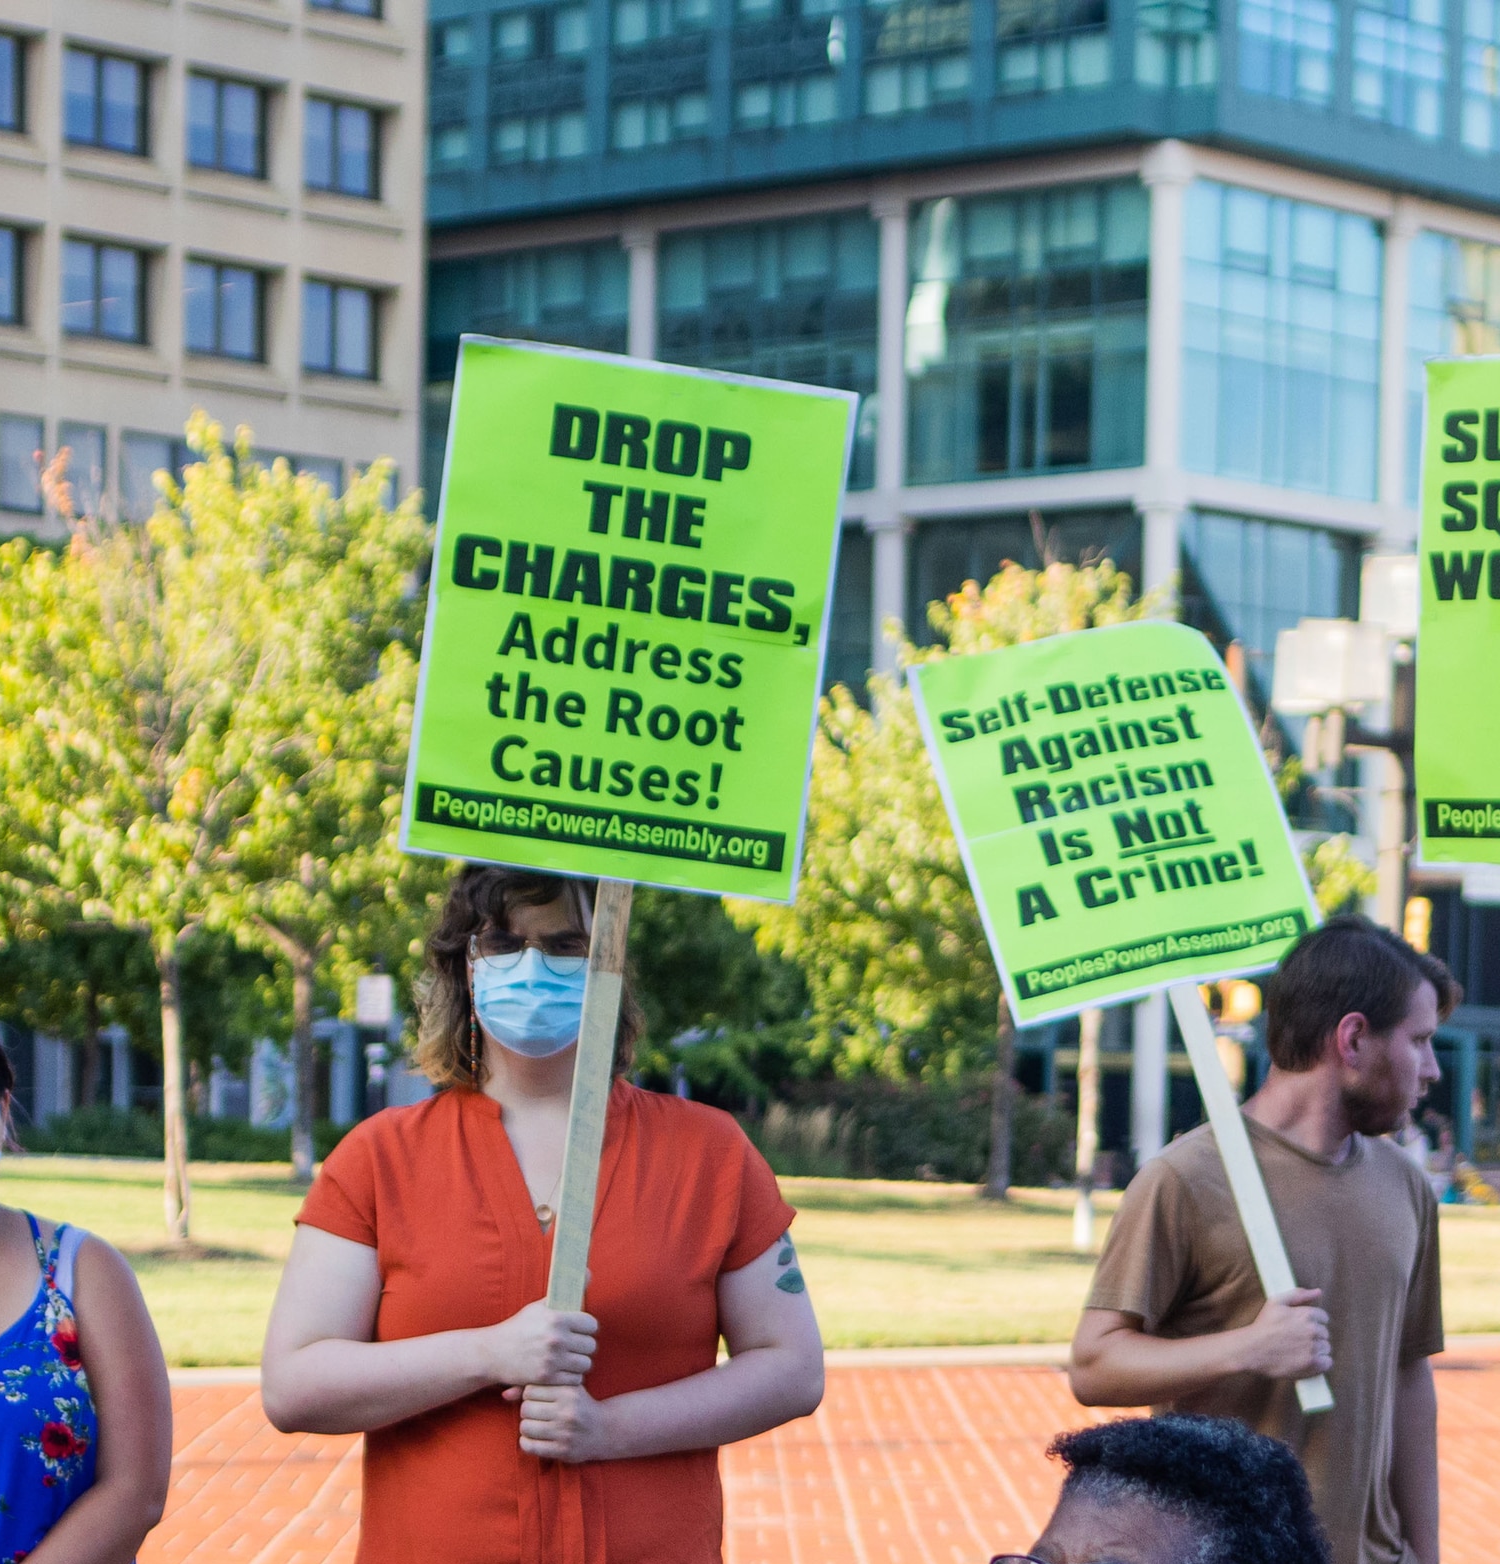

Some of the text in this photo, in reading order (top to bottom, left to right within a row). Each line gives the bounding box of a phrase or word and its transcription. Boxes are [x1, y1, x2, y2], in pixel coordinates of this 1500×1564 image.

[549, 402, 752, 482] DROP
[582, 479, 707, 548] THE
[452, 533, 811, 646] CHARGES,
[497, 611, 744, 690] Address
[486, 671, 746, 751] the Root
[940, 668, 1225, 743] Self-Defense
[1000, 703, 1202, 775] Against
[490, 734, 724, 811] Causes!
[1013, 758, 1214, 823] Racism
[434, 791, 768, 862] PeoplesPowerAssembly.org
[1037, 799, 1212, 866] Is Not
[1016, 838, 1265, 926] A Crime!
[1027, 915, 1296, 989] PeoplesPowerAssembly.org
